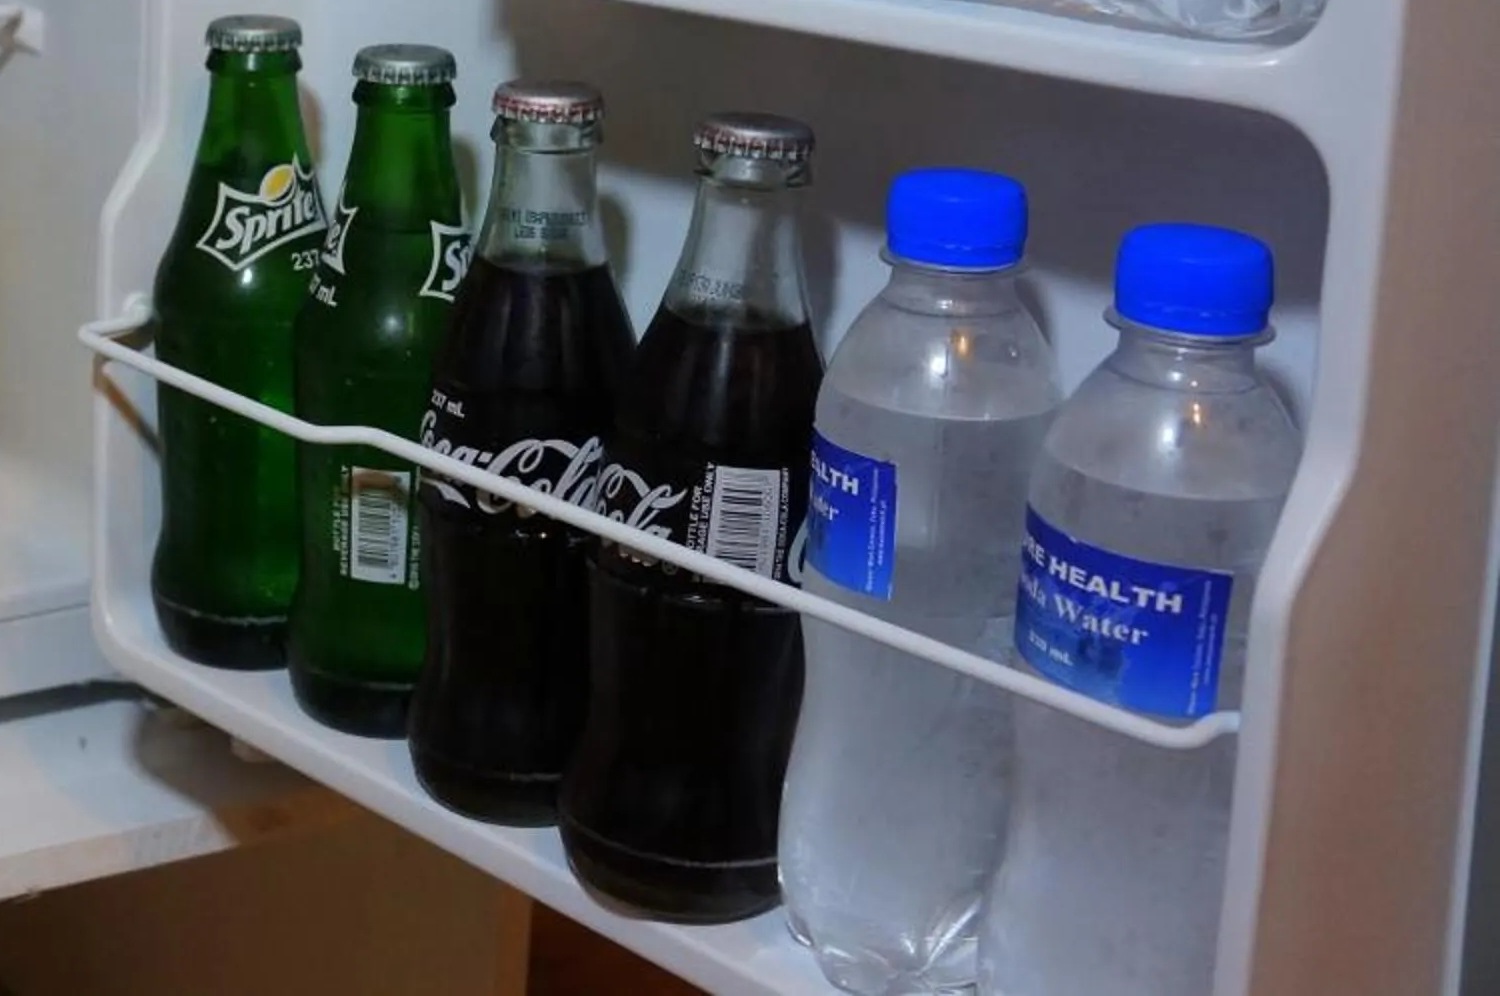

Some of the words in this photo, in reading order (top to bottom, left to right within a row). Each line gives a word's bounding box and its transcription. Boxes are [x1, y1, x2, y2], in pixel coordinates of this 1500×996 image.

[215, 188, 318, 254] Sprite
[291, 249, 319, 270] 237
[1049, 556, 1183, 614] HEALTH
[1054, 593, 1149, 645] Water
